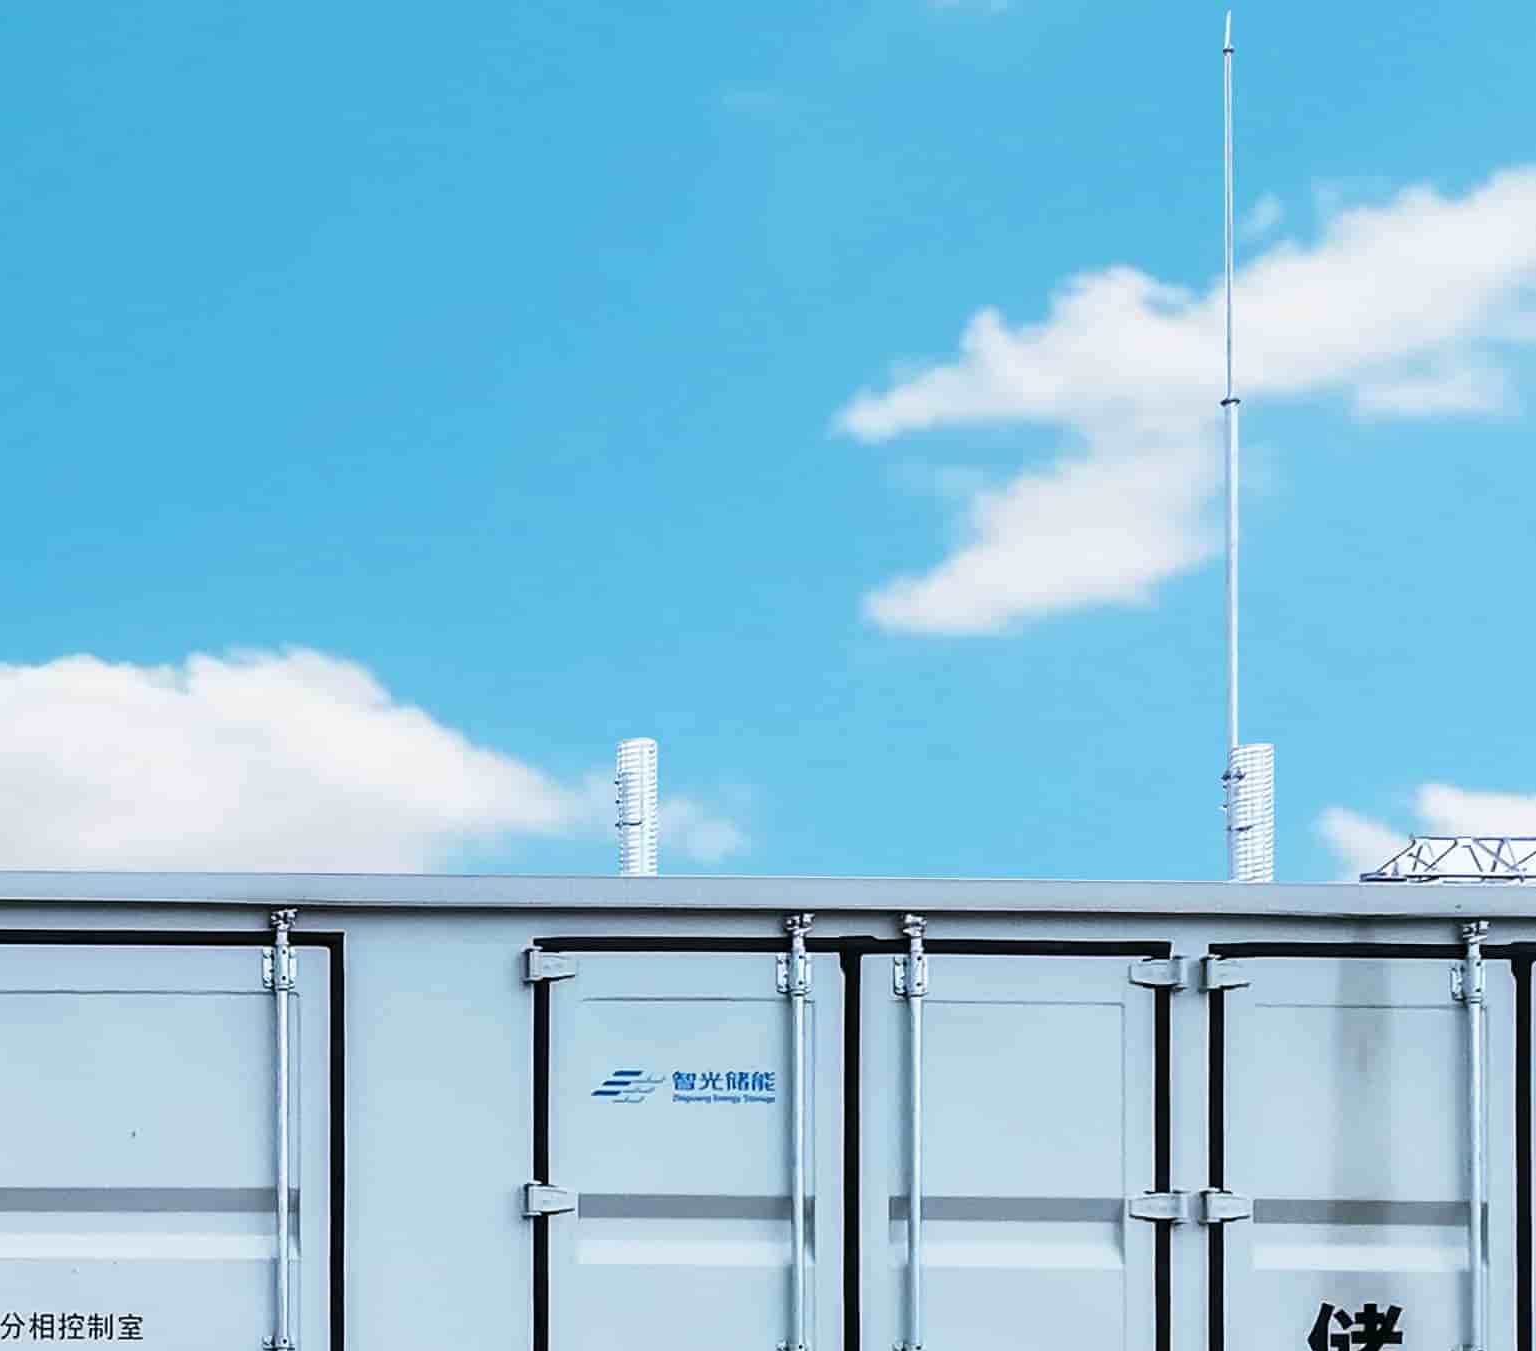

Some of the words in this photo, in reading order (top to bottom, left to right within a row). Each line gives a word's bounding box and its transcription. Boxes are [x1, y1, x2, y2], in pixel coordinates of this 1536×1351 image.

[1, 1312, 143, 1339] 分相控制室
